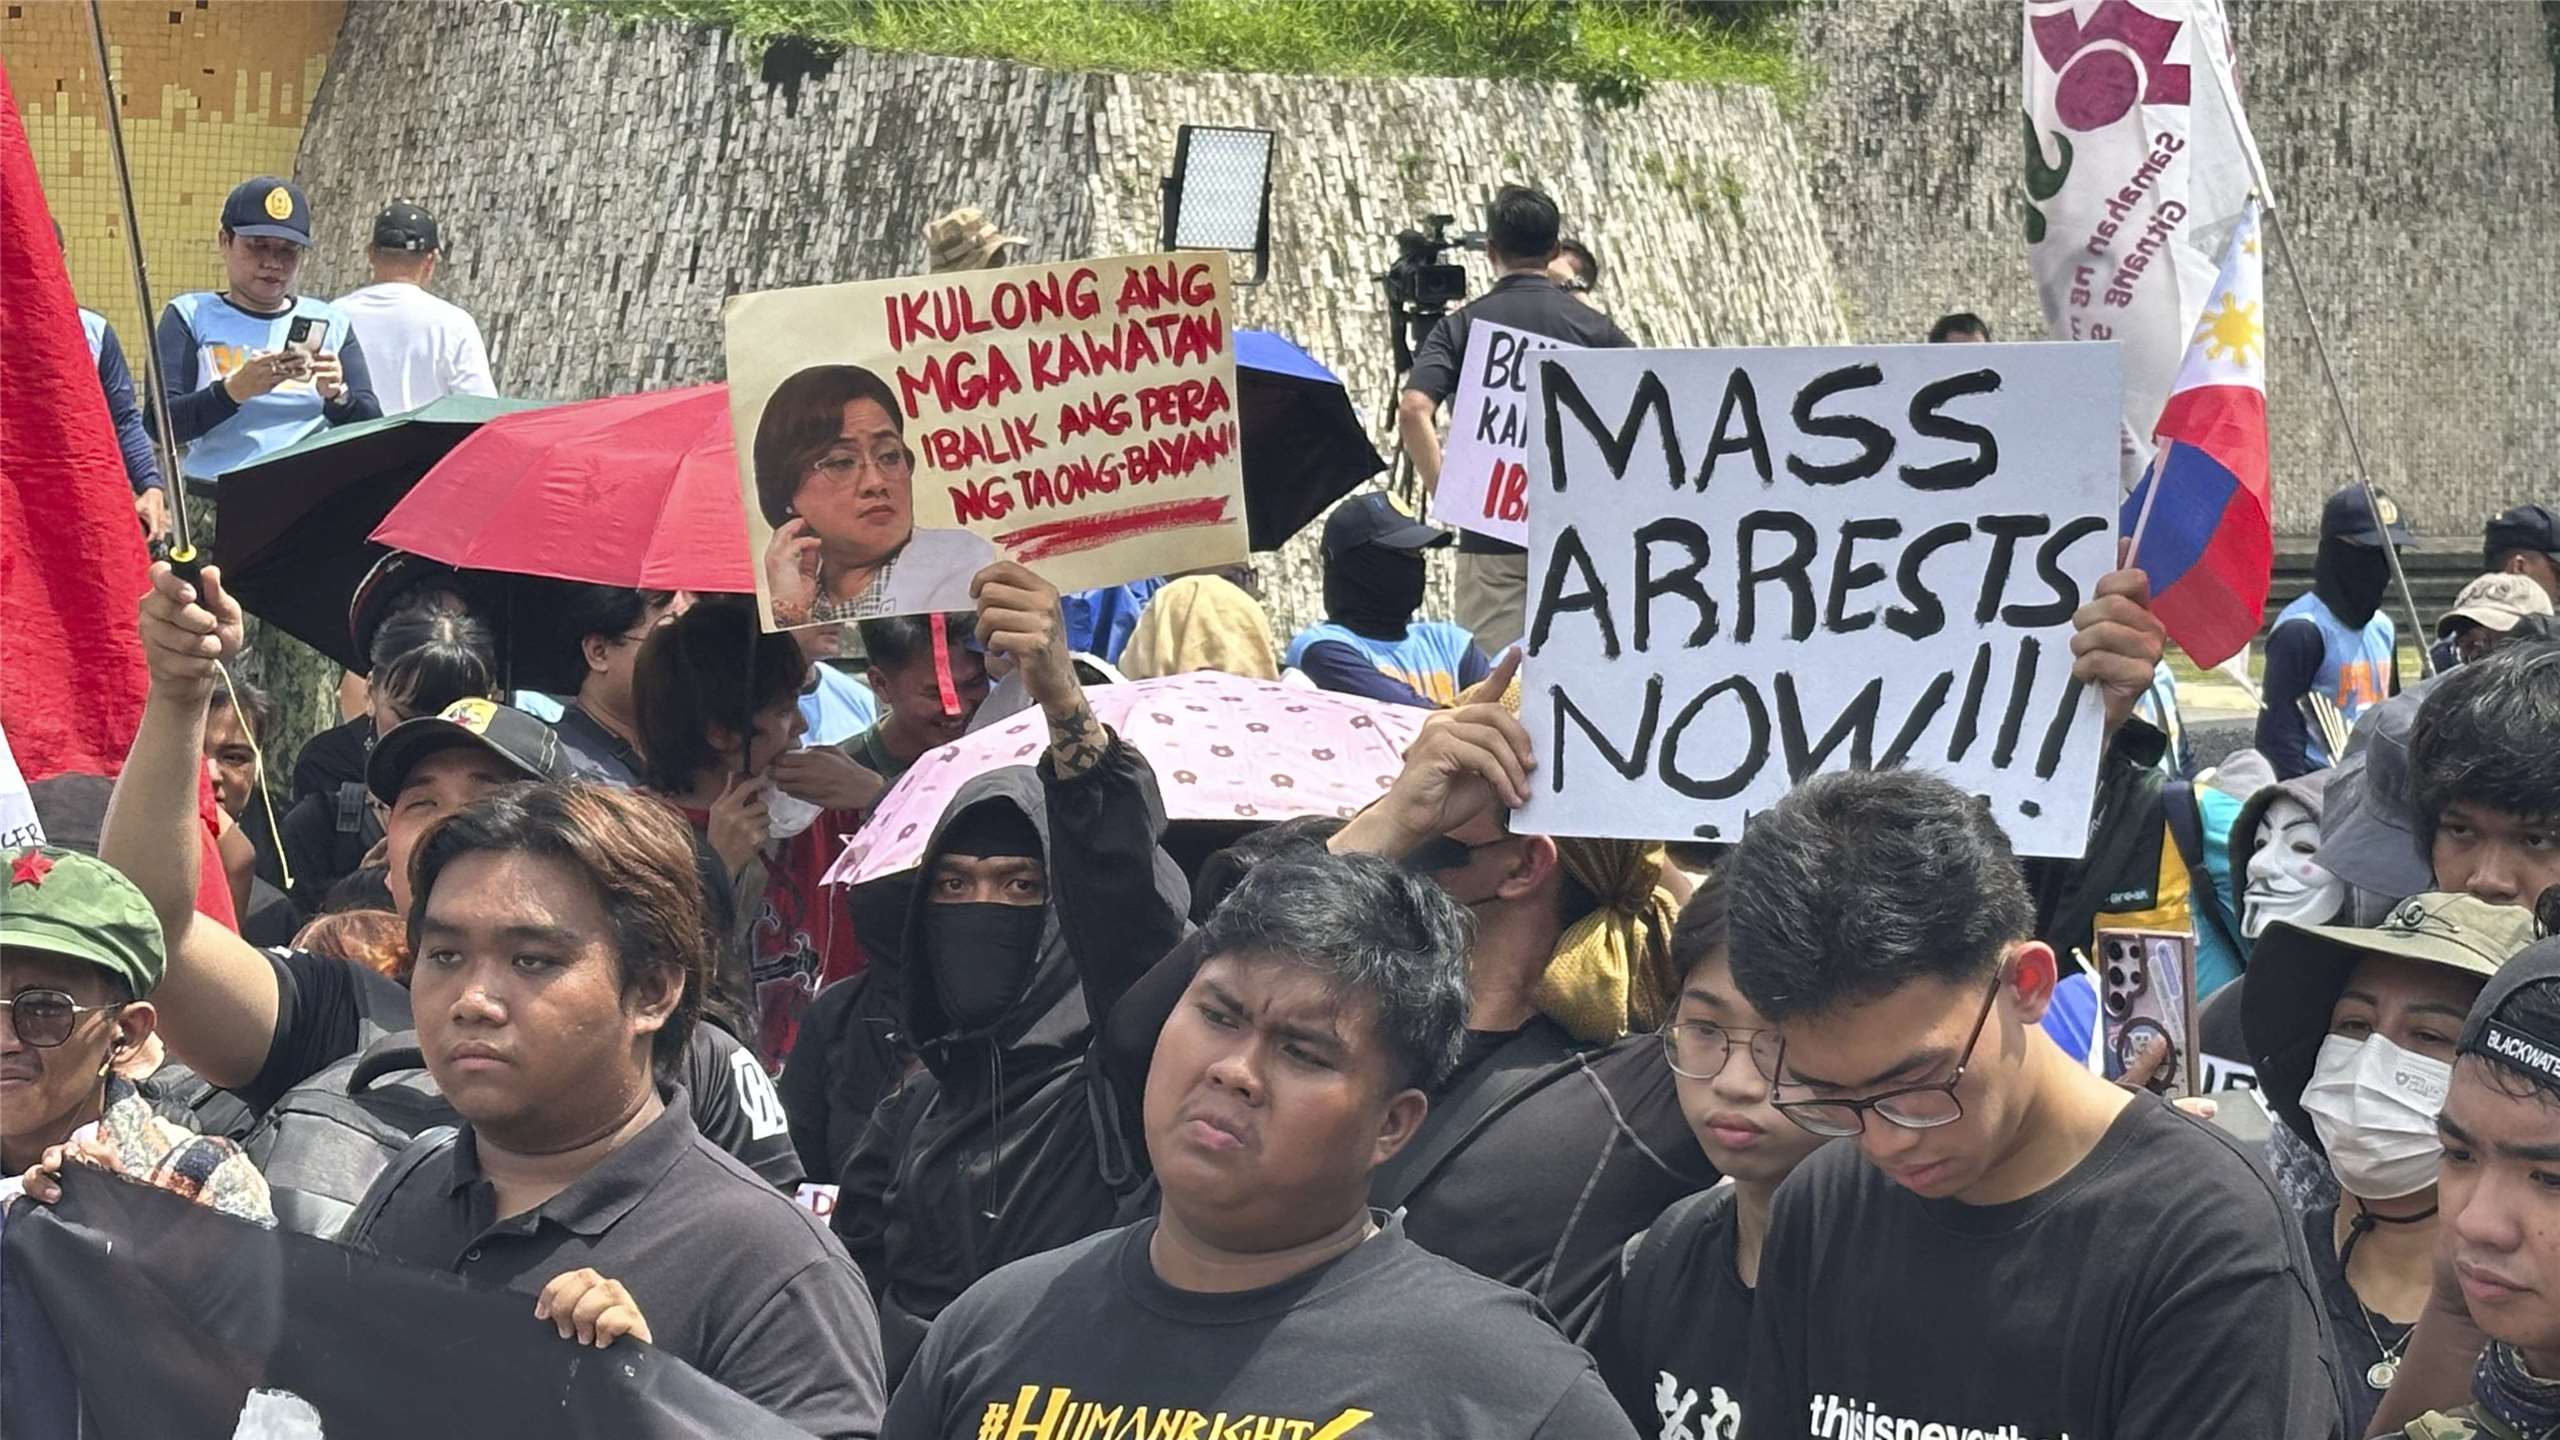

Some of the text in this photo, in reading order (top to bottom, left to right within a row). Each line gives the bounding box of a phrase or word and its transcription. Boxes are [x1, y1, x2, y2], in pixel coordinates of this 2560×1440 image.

[885, 259, 1216, 353] IKULONG ANG
[896, 306, 1223, 419] MGA KAWATAN
[921, 376, 1231, 471] IBALIK ANG PERA
[948, 420, 1237, 526] NG TAONG-BAYAN!
[1476, 396, 1526, 449] KA
[1540, 358, 2002, 493] MASS
[1482, 458, 1527, 523] IB
[1528, 510, 2109, 659] ARRESTS
[1552, 635, 2083, 817] NOW!!!
